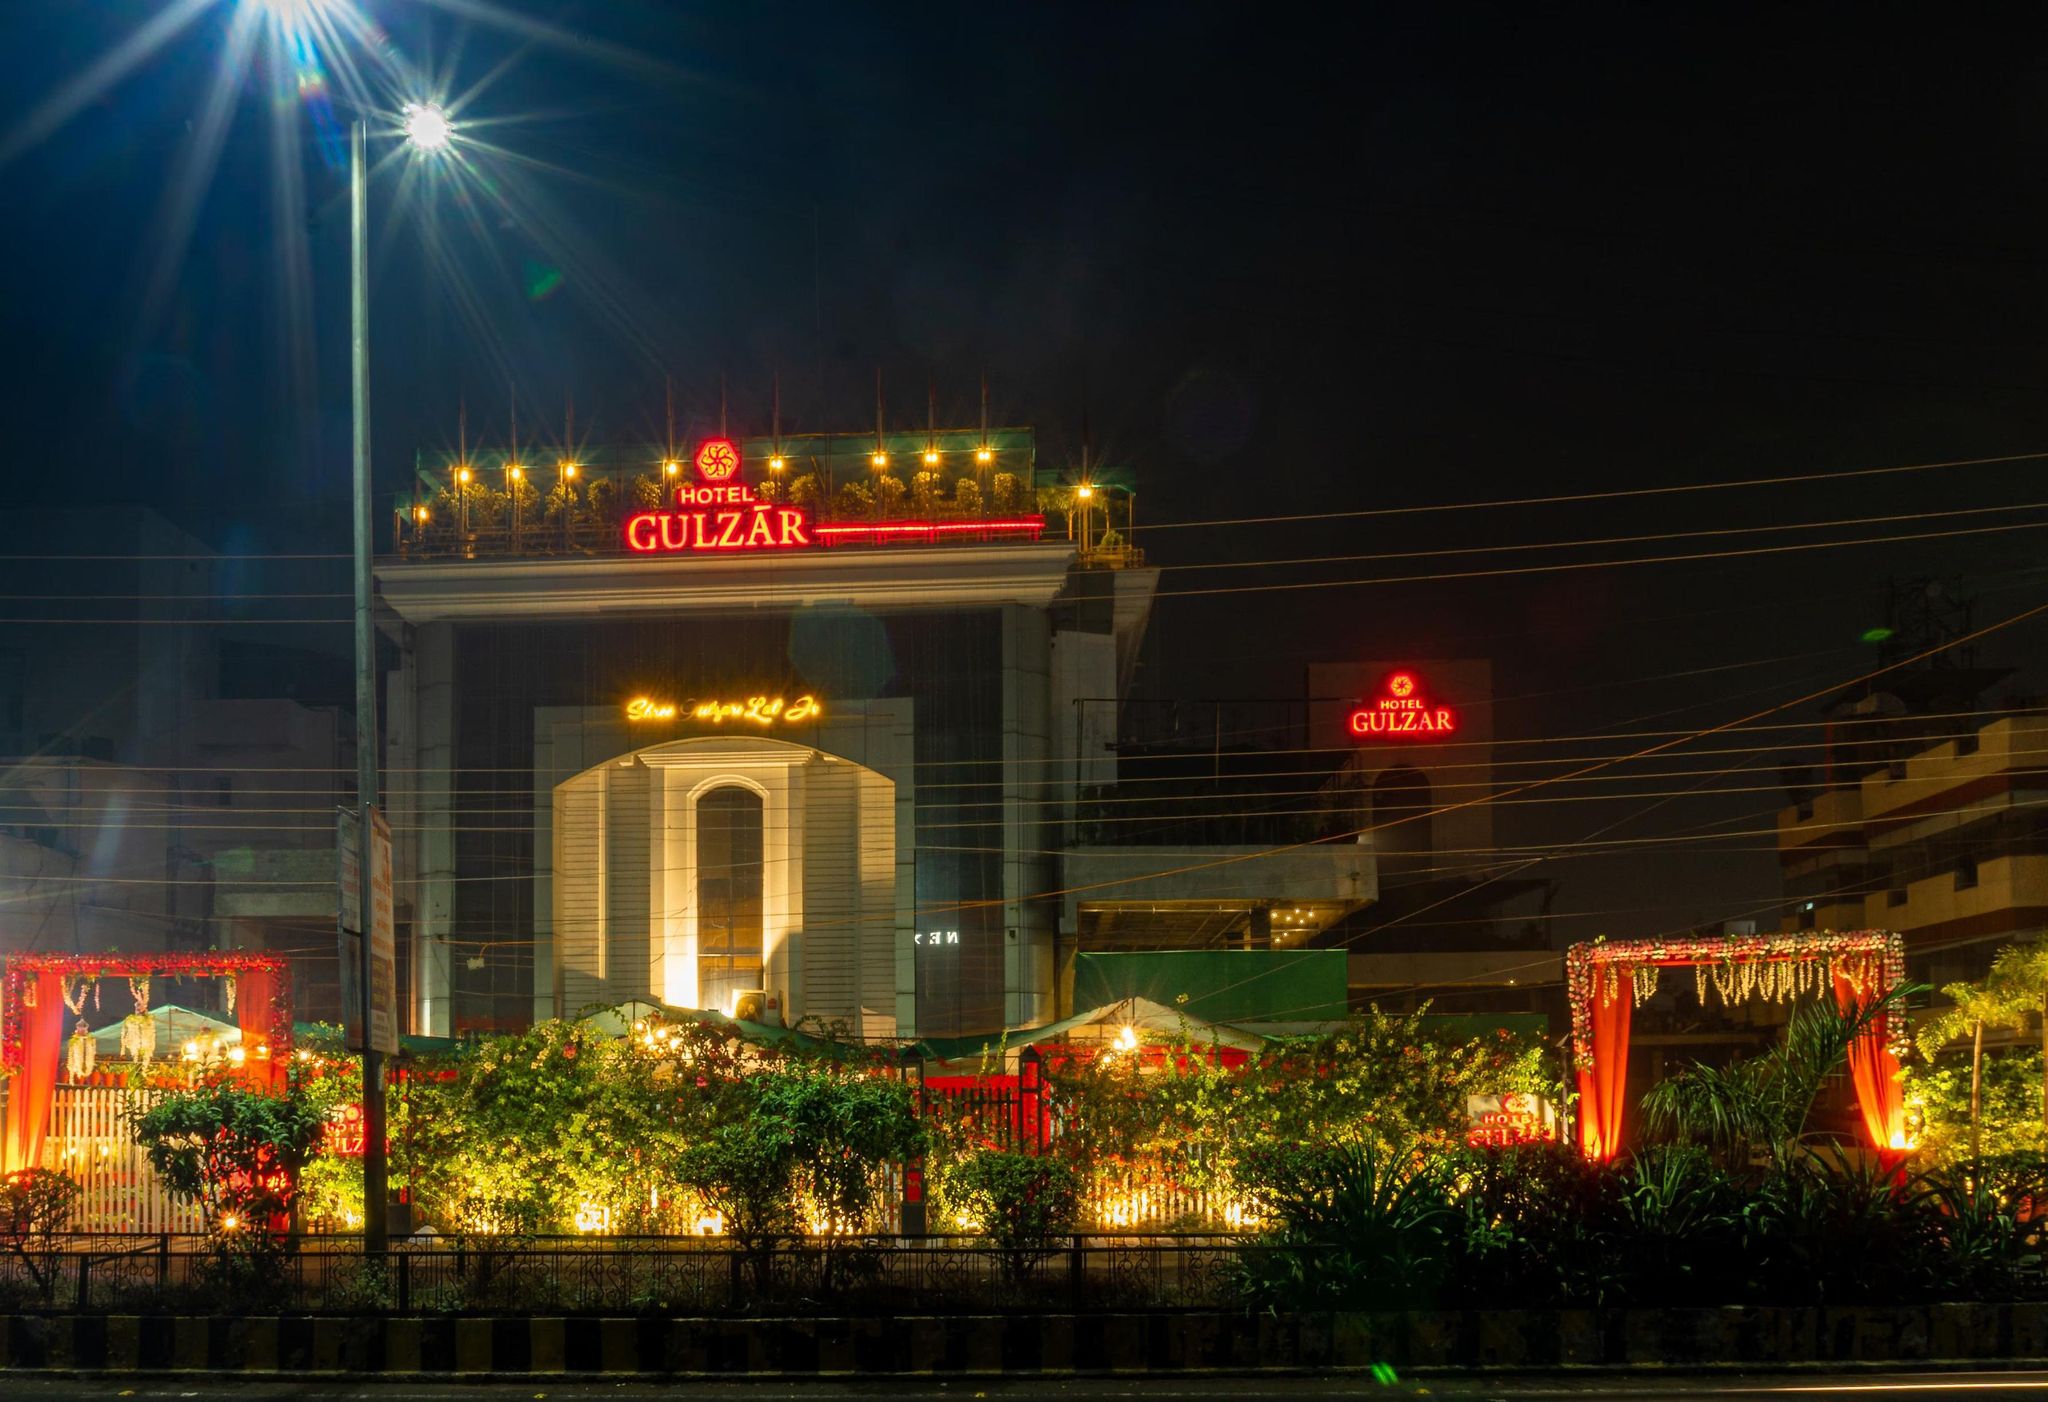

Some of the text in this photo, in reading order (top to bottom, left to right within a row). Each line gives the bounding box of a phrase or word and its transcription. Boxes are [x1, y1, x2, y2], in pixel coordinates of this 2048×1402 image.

[681, 487, 755, 504] HOTEL
[744, 695, 784, 724] Lal
[1380, 700, 1423, 709] HOTEL
